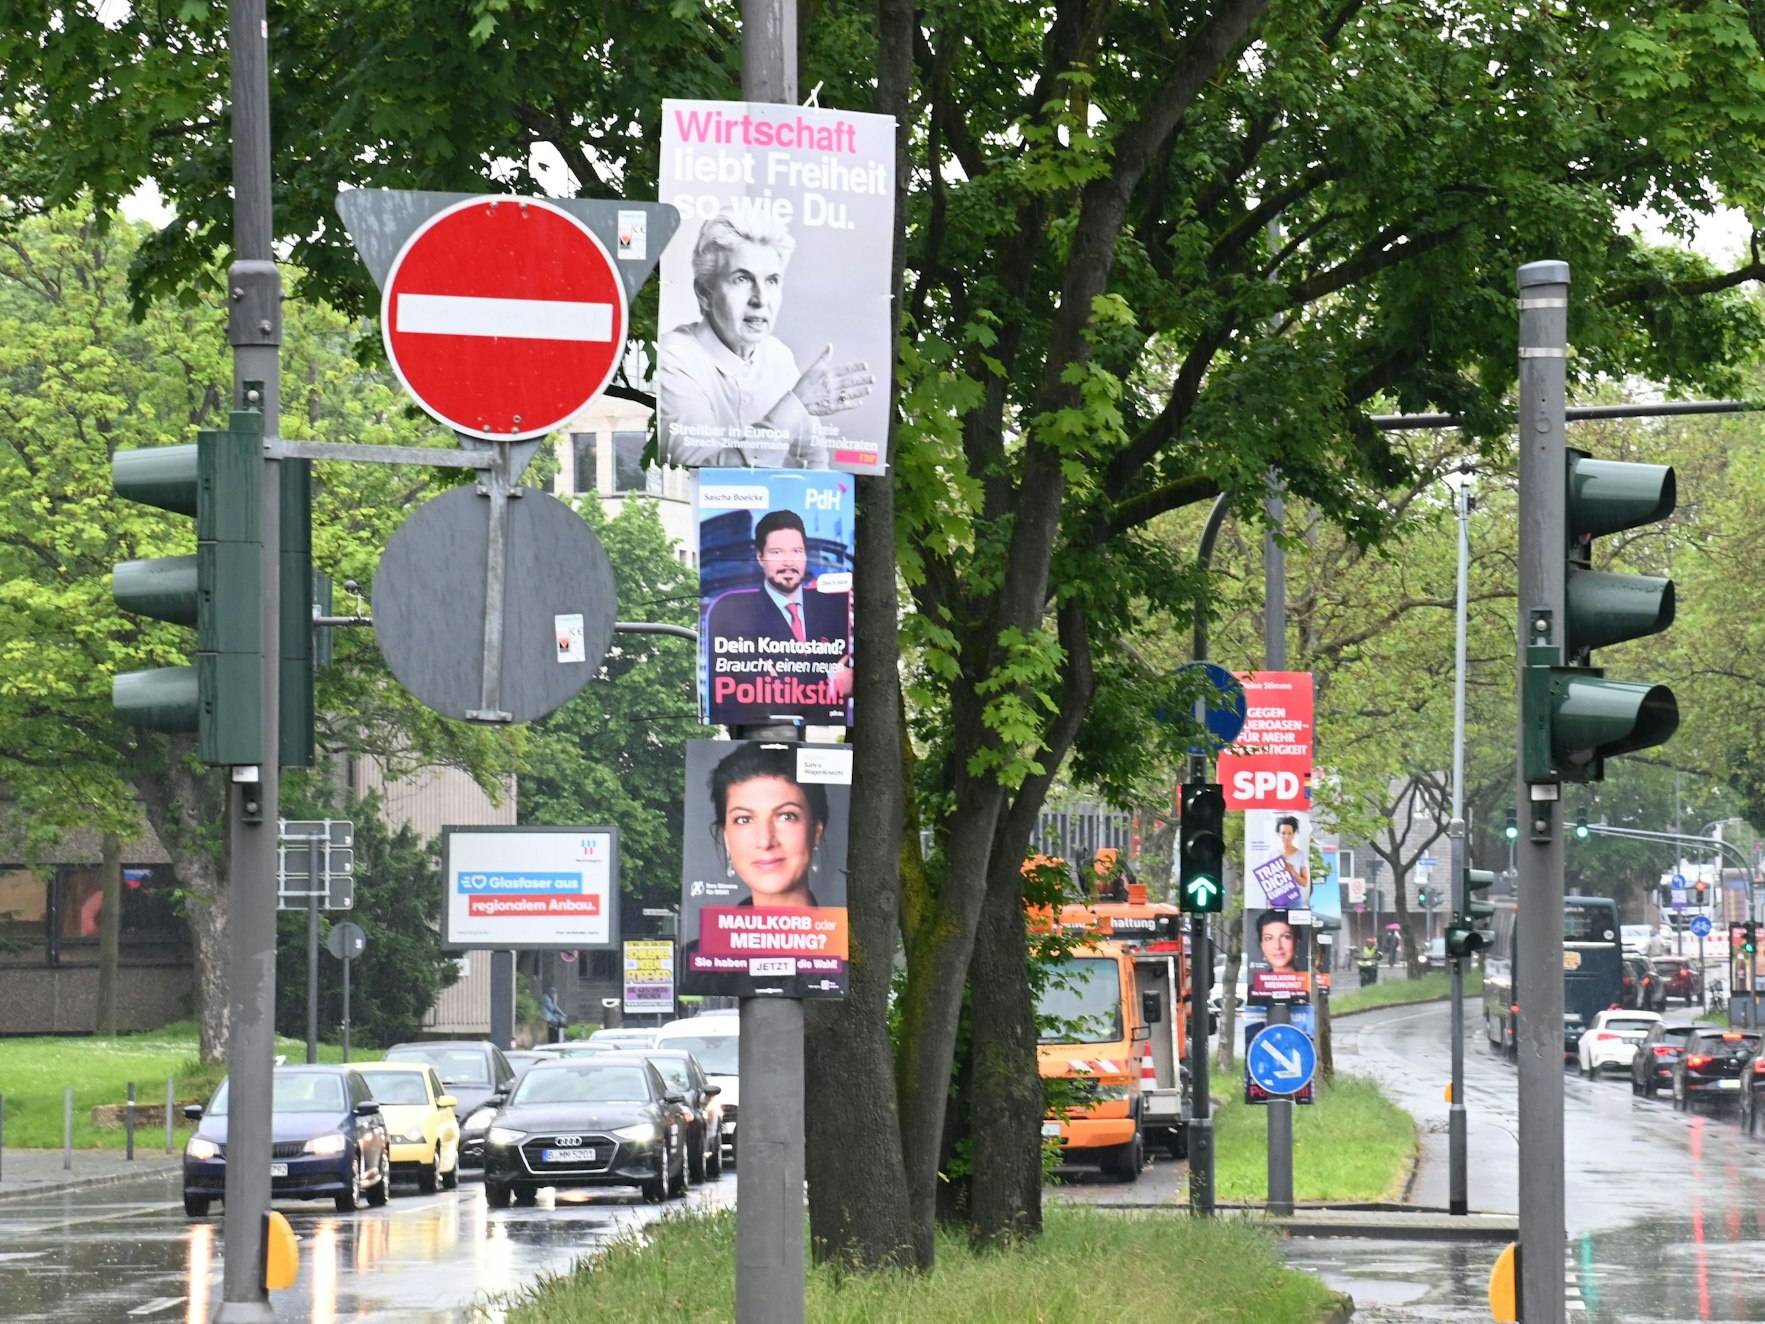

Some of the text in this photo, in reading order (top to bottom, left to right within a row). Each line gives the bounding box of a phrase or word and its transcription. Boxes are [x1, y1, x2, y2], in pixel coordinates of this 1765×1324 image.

[674, 110, 856, 154] Wirtschaft
[673, 148, 888, 196] liebt Freiheit
[673, 188, 855, 231] so wie Du.
[668, 421, 791, 441] Streitbar in Europa
[810, 435, 879, 452] Demokraten
[805, 488, 841, 511] PdH
[714, 636, 846, 655] Dein Kontostand?
[715, 657, 845, 674] Braucht einen neuen
[714, 675, 845, 705] Politikstil!
[1246, 707, 1286, 719] GEGEN
[1243, 719, 1310, 731] UEROASEN-
[1237, 730, 1296, 743] FÜR MEHR
[1232, 770, 1300, 800] SPD
[1254, 858, 1286, 881] TRAU
[489, 876, 579, 889] Glasfaser aus
[1260, 870, 1292, 893] DICH
[472, 899, 597, 915] regionalem Anbau.
[718, 915, 836, 931] MAULKORB oder
[730, 932, 827, 950] MEINUNG?
[694, 957, 713, 968] Sie
[714, 958, 748, 968] haben
[757, 963, 789, 971] JETZT
